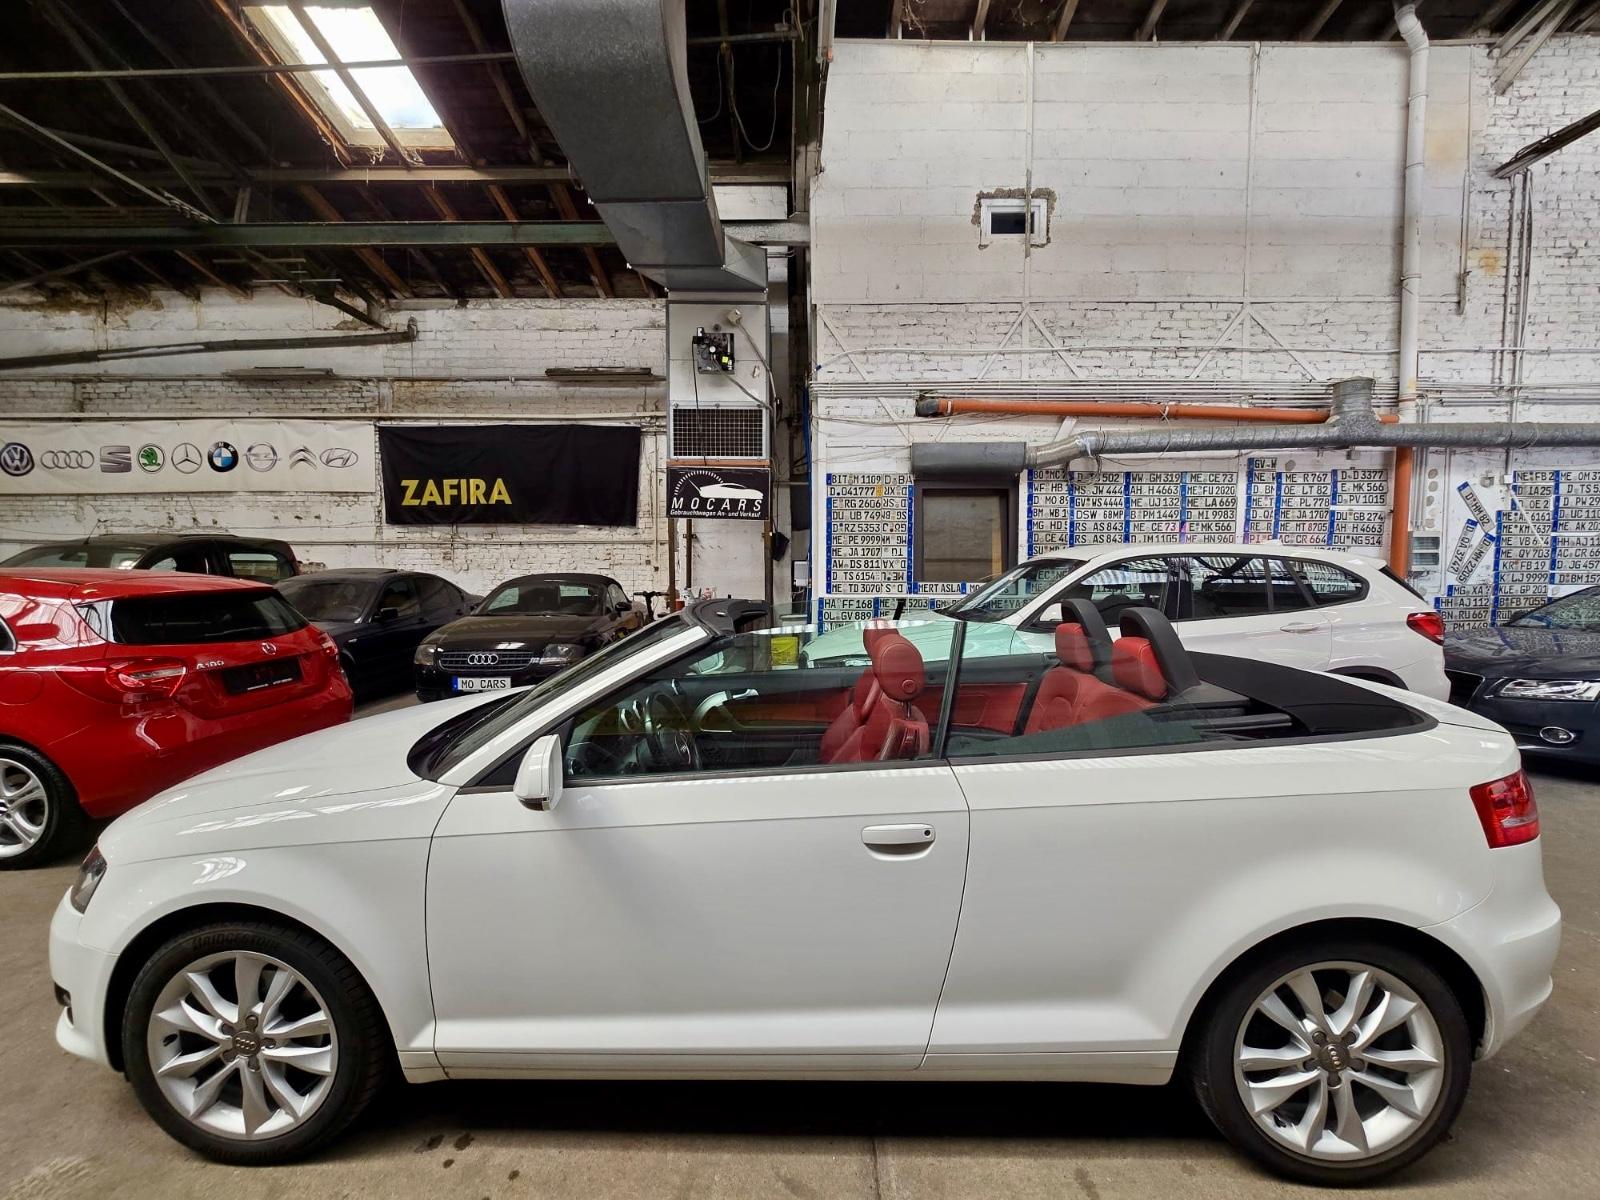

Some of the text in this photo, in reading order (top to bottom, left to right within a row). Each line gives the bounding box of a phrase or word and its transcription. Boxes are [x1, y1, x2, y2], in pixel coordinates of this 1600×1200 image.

[1190, 474, 1202, 482] ME
[1342, 470, 1348, 480] D
[1187, 486, 1198, 494] ME
[1340, 482, 1346, 492] E
[400, 478, 513, 506] ZAFIRA
[1465, 492, 1474, 501] D
[1076, 498, 1086, 507] GV
[1130, 498, 1142, 507] ME
[1186, 498, 1199, 508] ME
[1282, 498, 1292, 507] ME
[1338, 494, 1344, 504] D
[671, 497, 762, 512] MOCARS
[832, 500, 838, 508] E
[832, 512, 844, 520] DU
[1076, 510, 1098, 520] DSW
[1130, 510, 1136, 520] B
[1186, 510, 1192, 520] D
[1280, 510, 1290, 520] ME
[1336, 512, 1348, 521] DU
[832, 524, 838, 532] D
[1076, 522, 1086, 532] RS
[1134, 522, 1146, 532] ME
[1189, 522, 1196, 532] E
[1280, 522, 1290, 532] ME
[832, 536, 842, 544] ME
[1074, 534, 1086, 544] RS
[1334, 536, 1346, 545] DU
[832, 548, 842, 556] ME
[1500, 550, 1512, 558] ME
[832, 560, 844, 568] AW
[1502, 560, 1514, 570] KR
[1556, 560, 1564, 569] D
[832, 572, 838, 580] D
[1500, 574, 1506, 582] K
[832, 584, 842, 592] ME
[918, 584, 938, 592] MERT
[1500, 585, 1514, 594] KLE
[824, 600, 836, 608] HA
[1440, 598, 1453, 608] HH
[824, 612, 835, 620] OL
[462, 680, 506, 688] MO CARS
